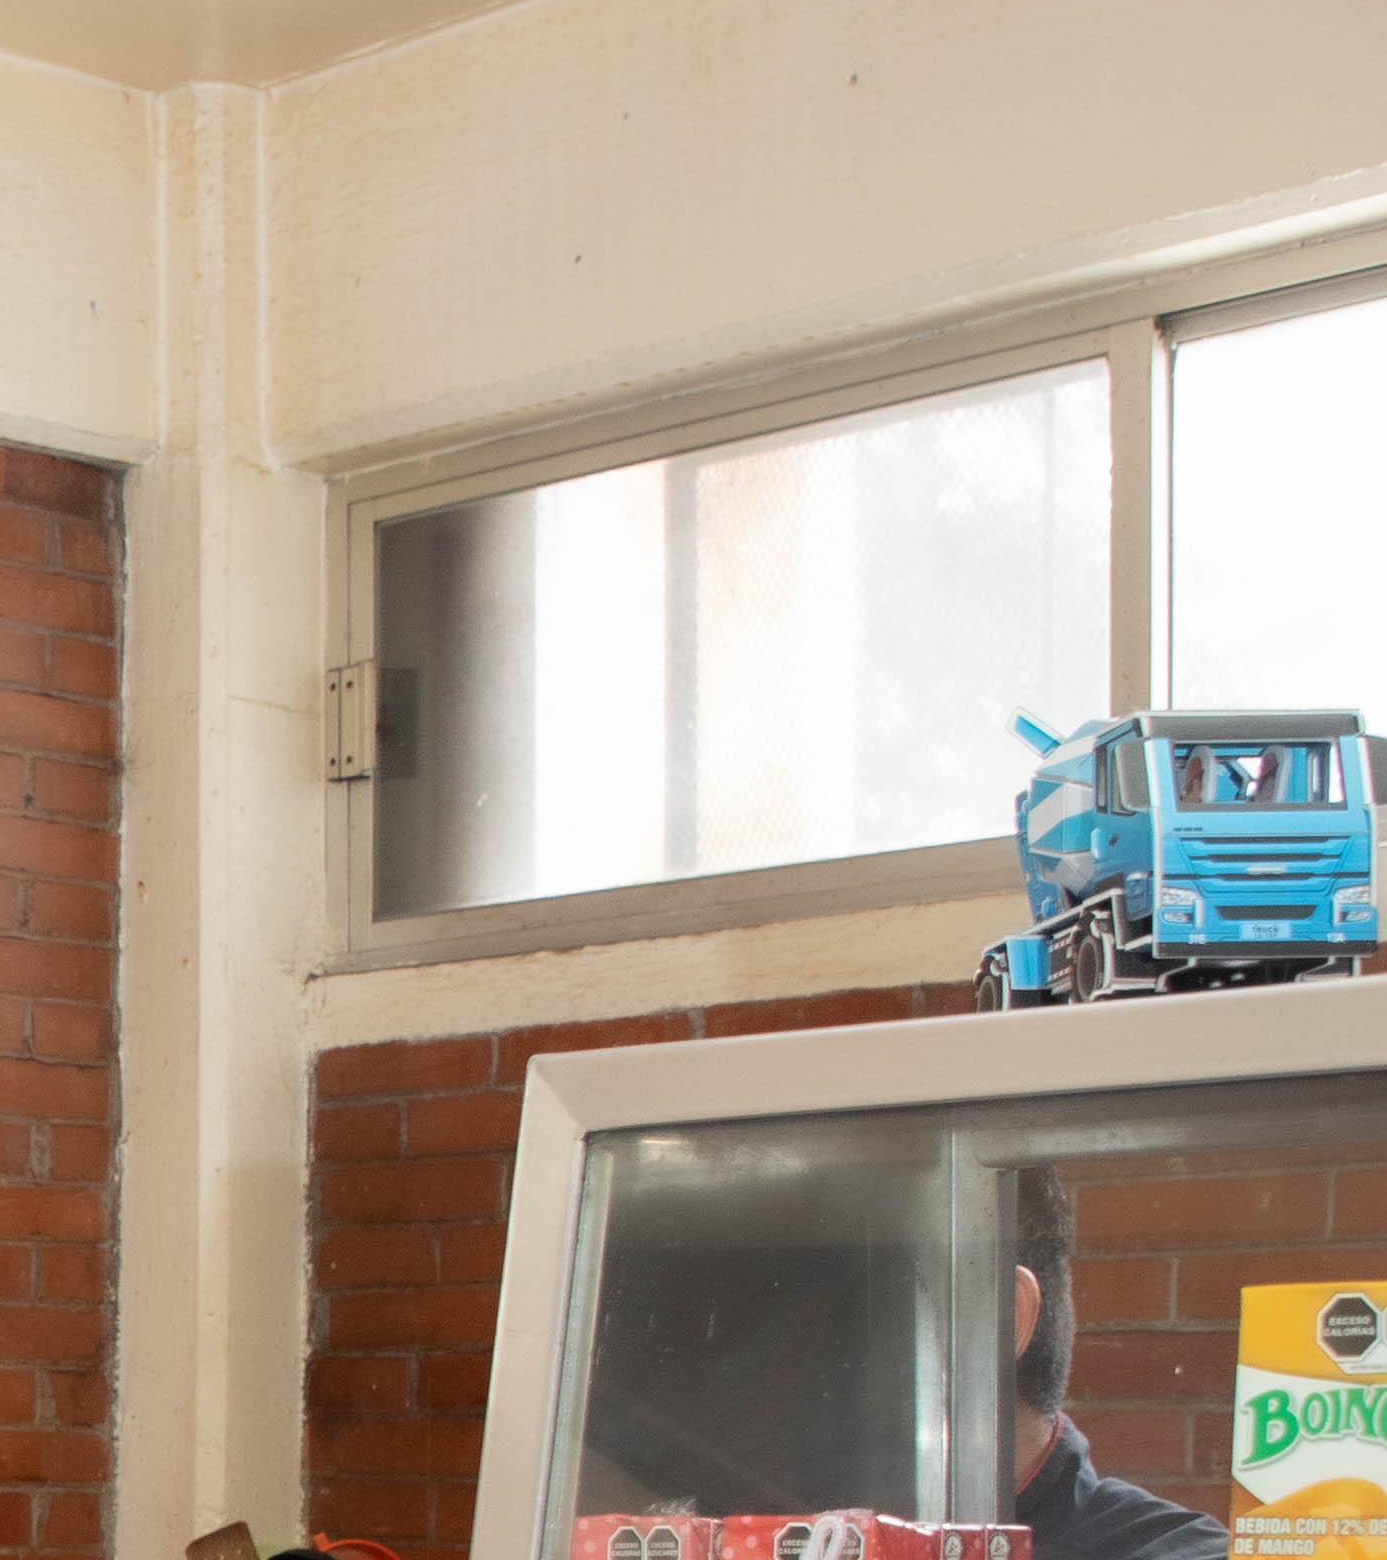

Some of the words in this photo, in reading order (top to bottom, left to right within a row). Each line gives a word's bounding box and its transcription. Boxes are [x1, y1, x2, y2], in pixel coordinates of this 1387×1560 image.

[1235, 1517, 1291, 1535] BEBIDA
[1296, 1519, 1326, 1535] CON
[1333, 1519, 1365, 1536] 12%
[1234, 1539, 1254, 1554] DE
[1258, 1539, 1315, 1555] MANGO
